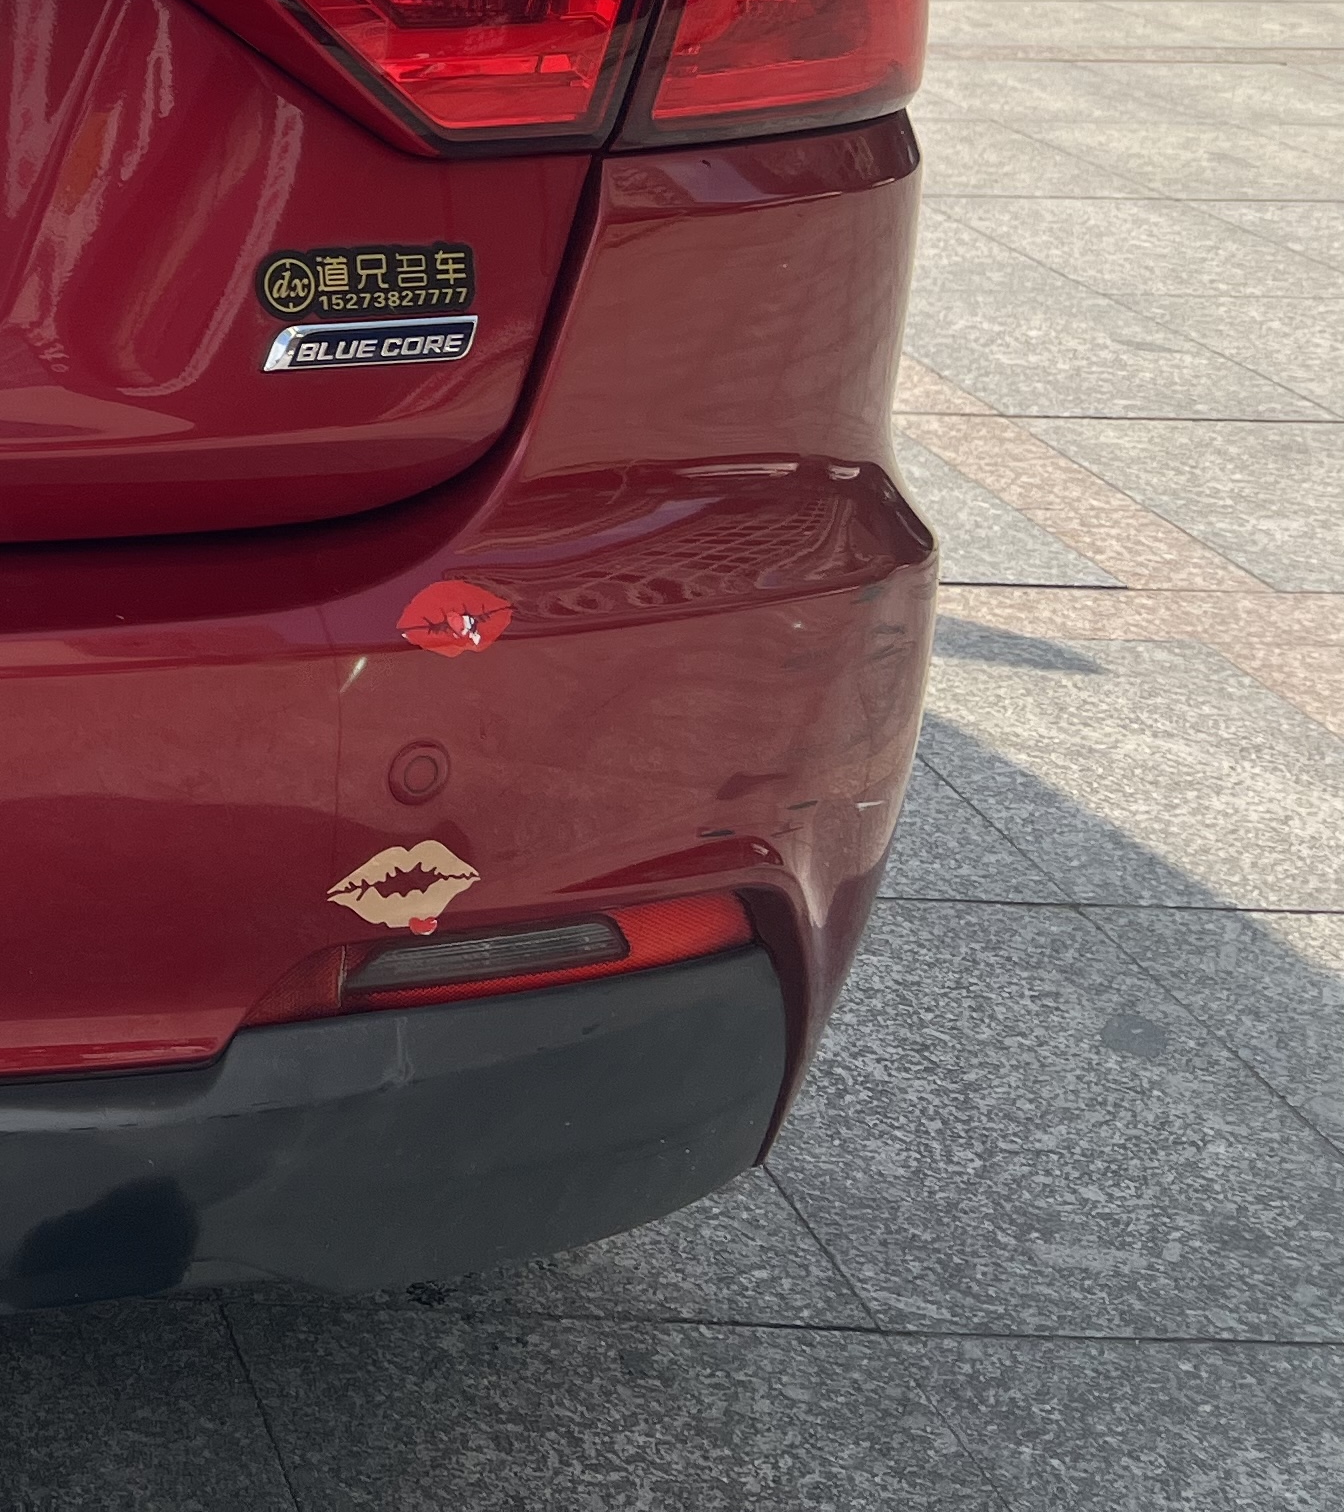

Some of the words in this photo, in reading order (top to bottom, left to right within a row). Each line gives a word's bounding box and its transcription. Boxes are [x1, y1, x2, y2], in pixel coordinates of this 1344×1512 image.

[315, 249, 467, 292] 道兄名车
[318, 287, 468, 311] 15273827777
[296, 339, 379, 363] BLUE
[380, 333, 465, 357] CORE
